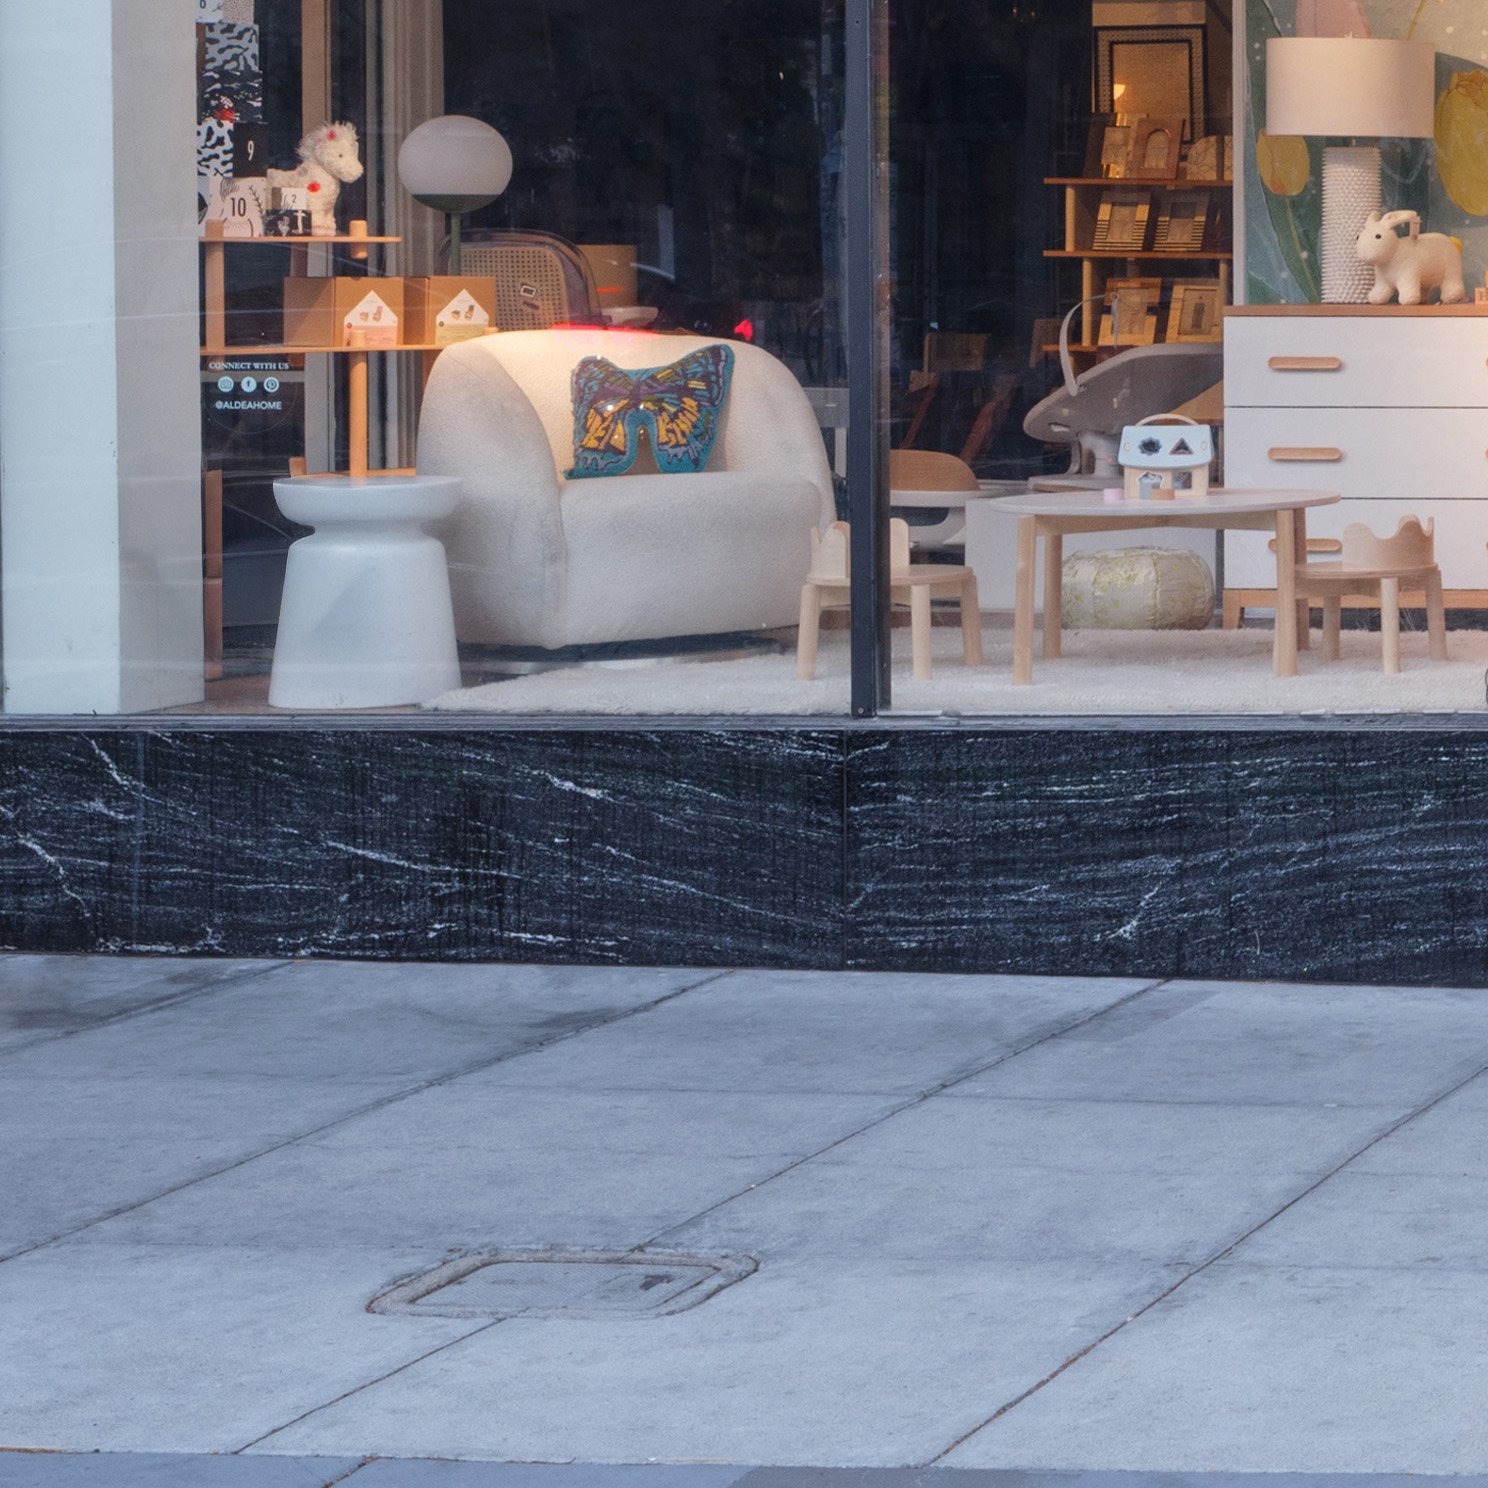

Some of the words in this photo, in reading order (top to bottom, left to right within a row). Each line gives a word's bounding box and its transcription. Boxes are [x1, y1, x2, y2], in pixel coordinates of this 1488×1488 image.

[247, 140, 255, 161] 9
[230, 197, 248, 217] 10
[208, 362, 252, 370] CONNECT
[253, 362, 277, 370] WITH
[278, 362, 289, 370] US
[215, 401, 283, 410] @ALDEAHOME
